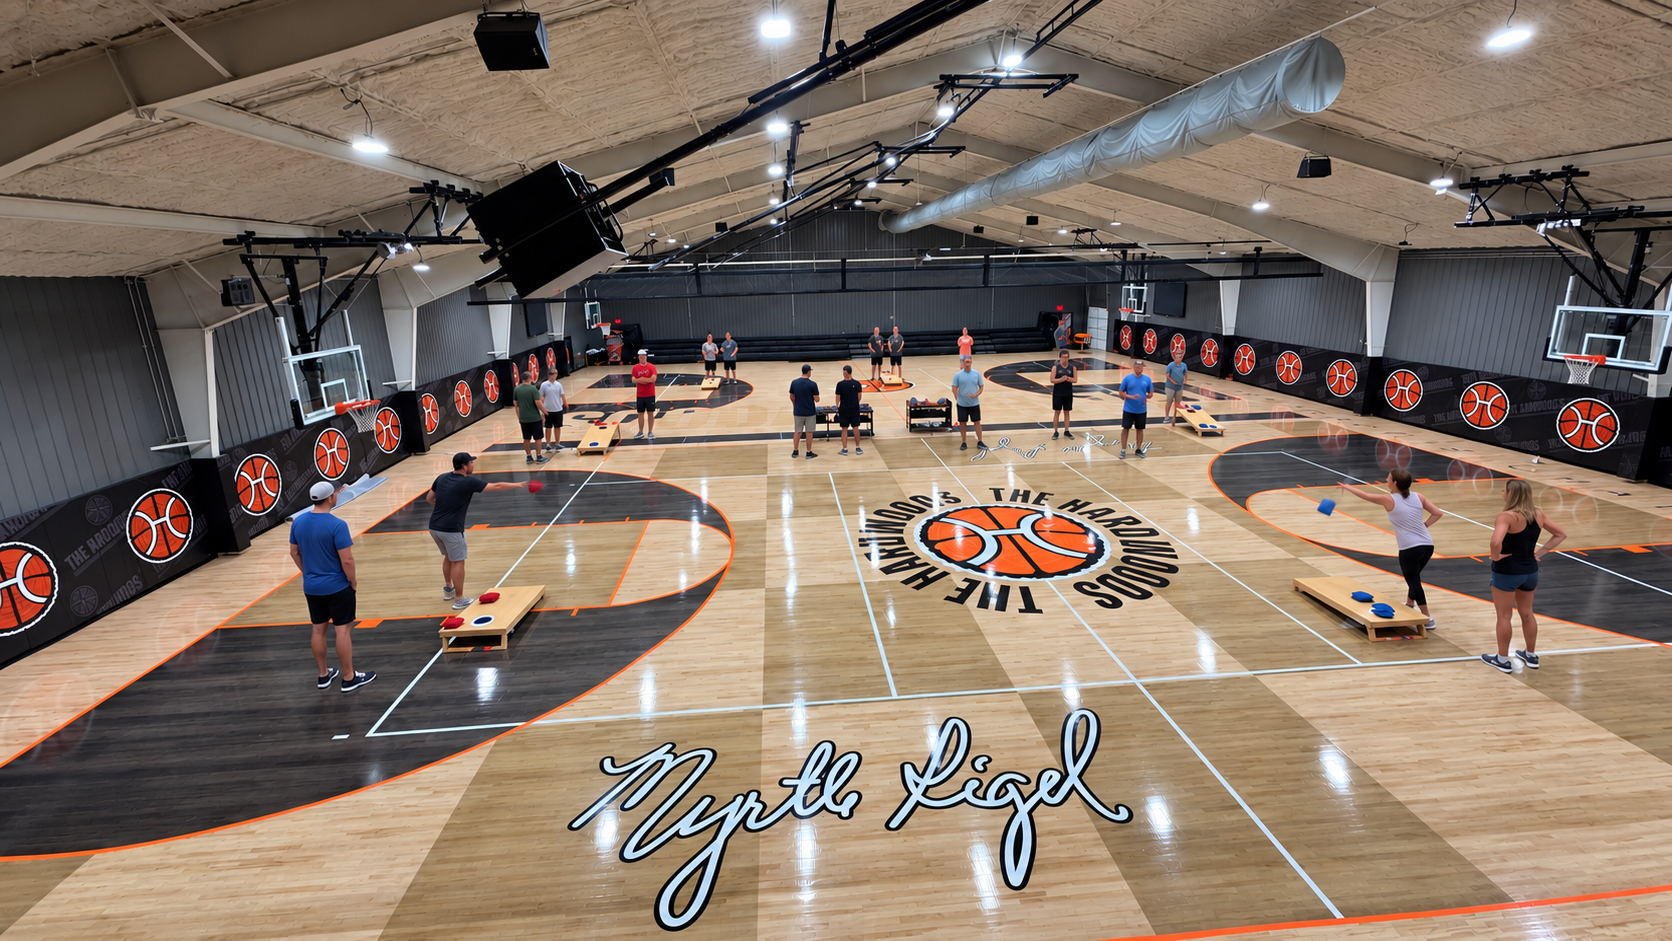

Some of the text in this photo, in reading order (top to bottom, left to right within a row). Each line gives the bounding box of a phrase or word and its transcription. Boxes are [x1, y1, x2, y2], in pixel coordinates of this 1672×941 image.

[989, 487, 1055, 506] THE
[63, 544, 91, 571] THE
[943, 577, 1043, 614] THE
